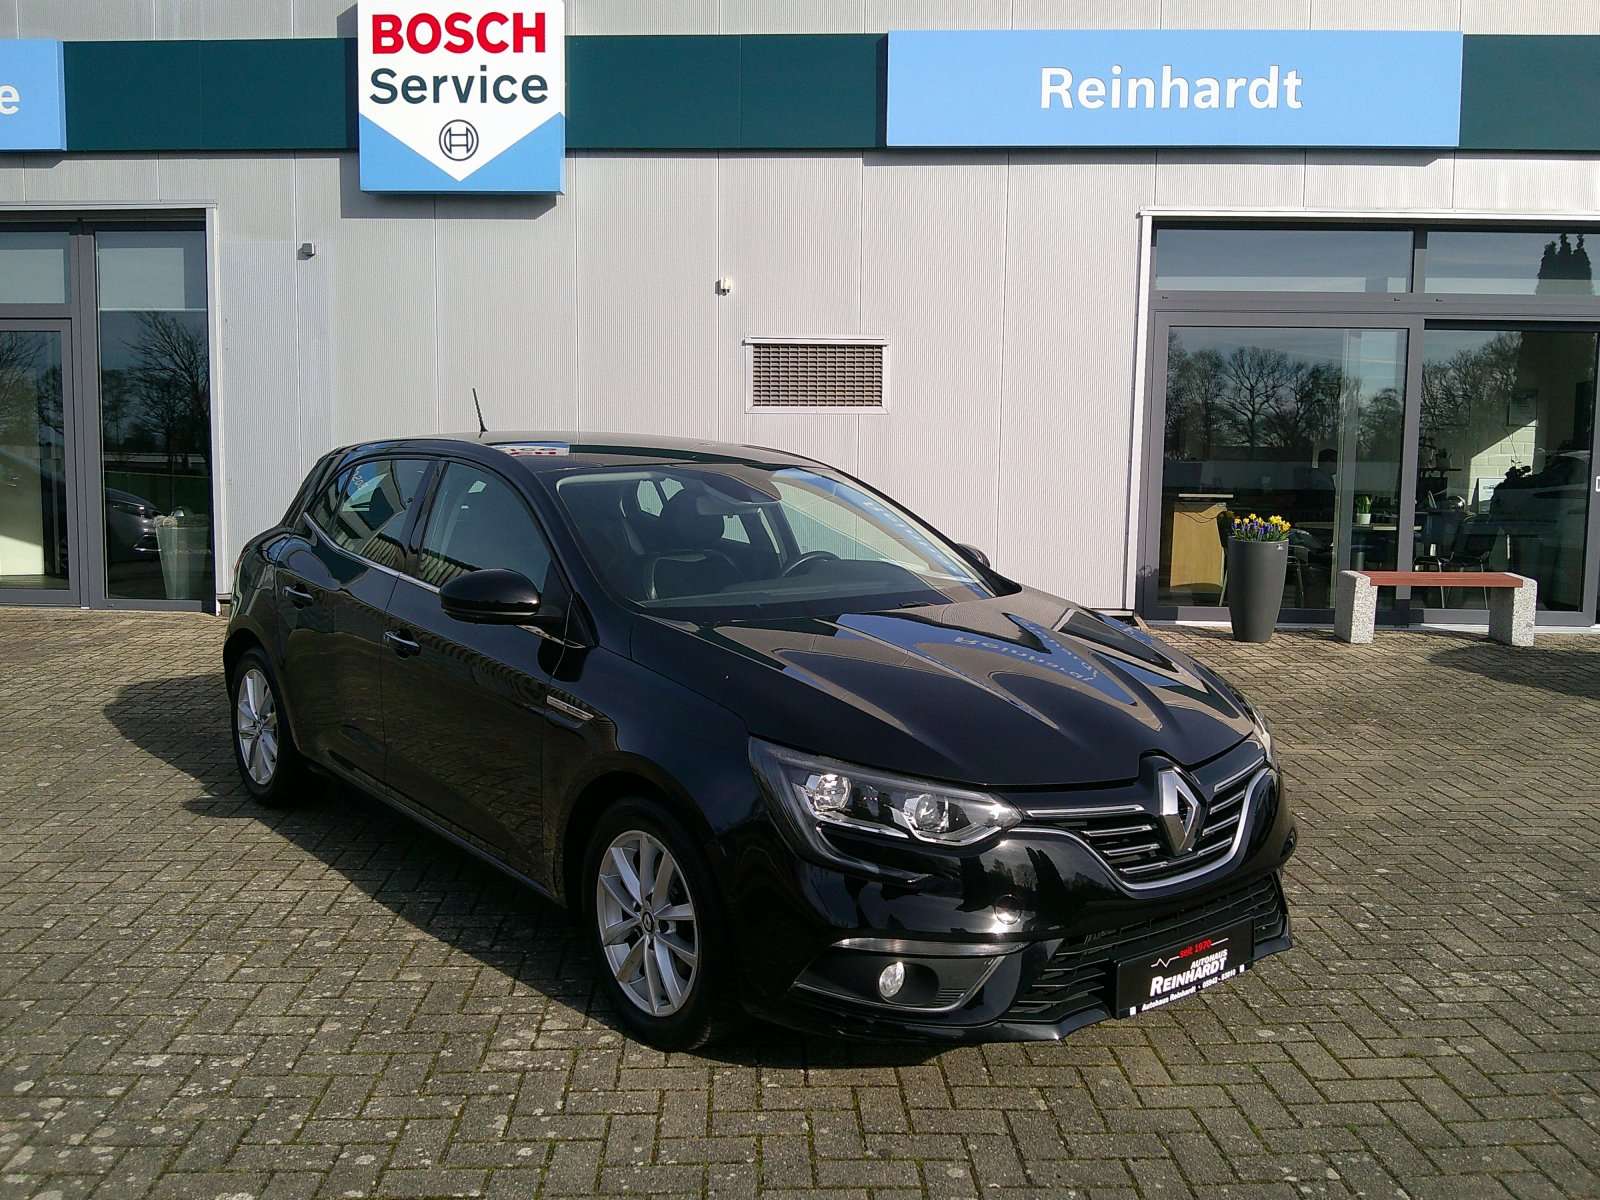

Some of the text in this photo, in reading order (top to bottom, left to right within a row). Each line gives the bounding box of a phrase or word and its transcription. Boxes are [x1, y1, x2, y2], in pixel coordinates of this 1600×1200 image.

[371, 12, 546, 55] BOSCH
[370, 64, 549, 105] Service
[1039, 64, 1304, 111] Reinhardt
[1190, 949, 1228, 969] AUTOHAUS
[1195, 939, 1212, 953] 1970
